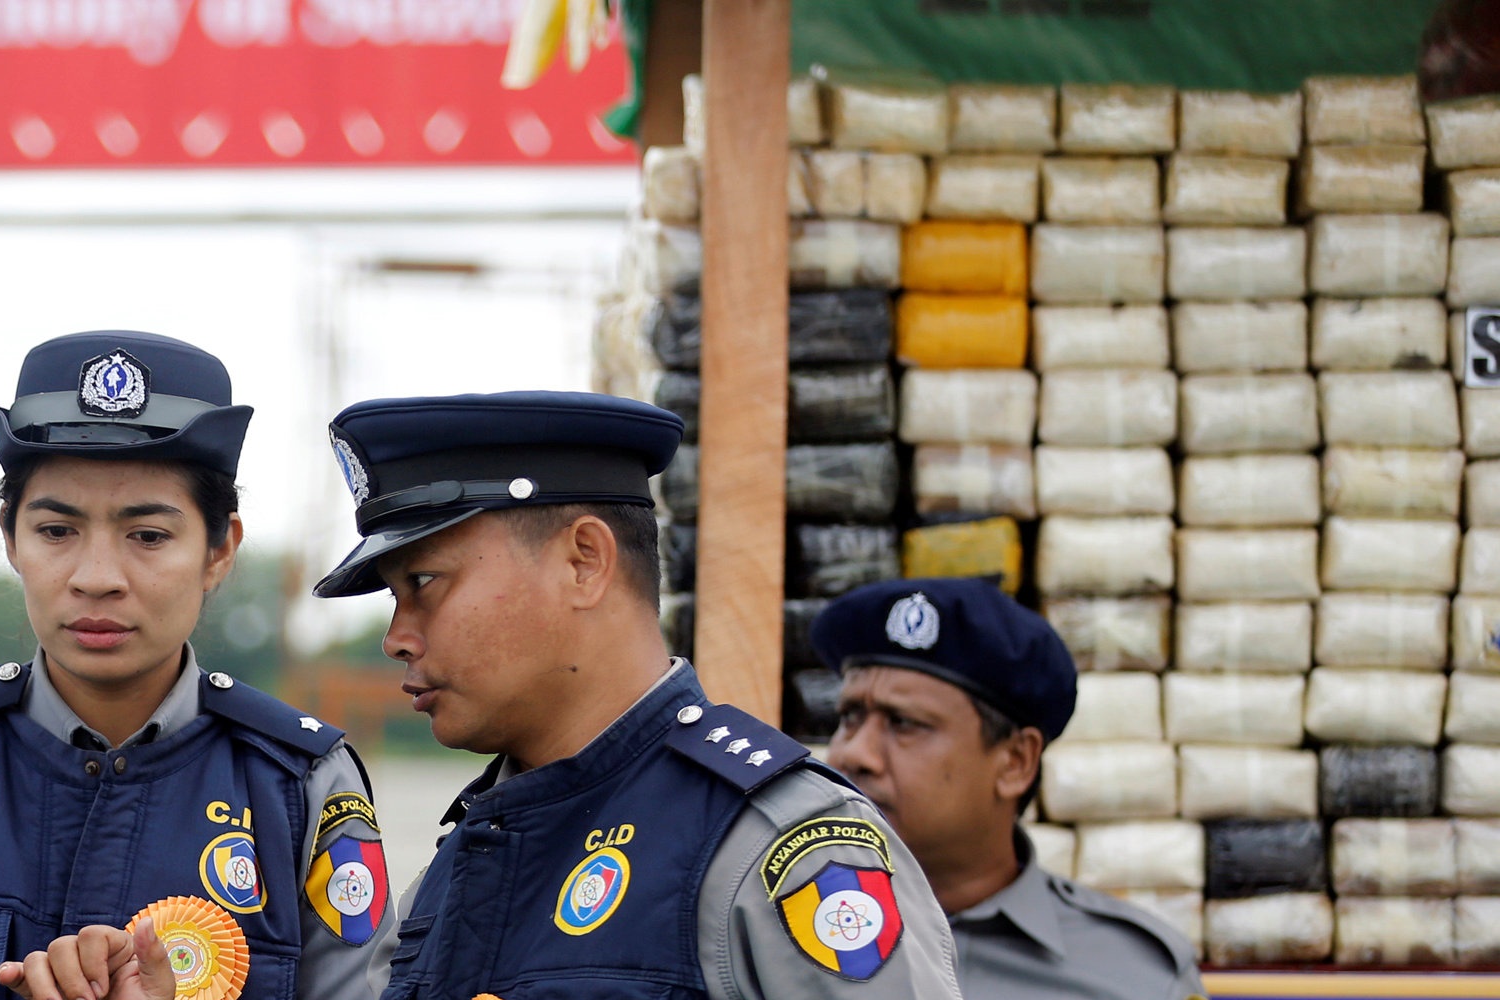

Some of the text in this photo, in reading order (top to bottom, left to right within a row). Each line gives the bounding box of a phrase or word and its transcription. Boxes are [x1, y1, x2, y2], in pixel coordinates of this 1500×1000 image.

[339, 799, 374, 821] POLICE
[768, 826, 881, 875] MYANMAR POLICE
